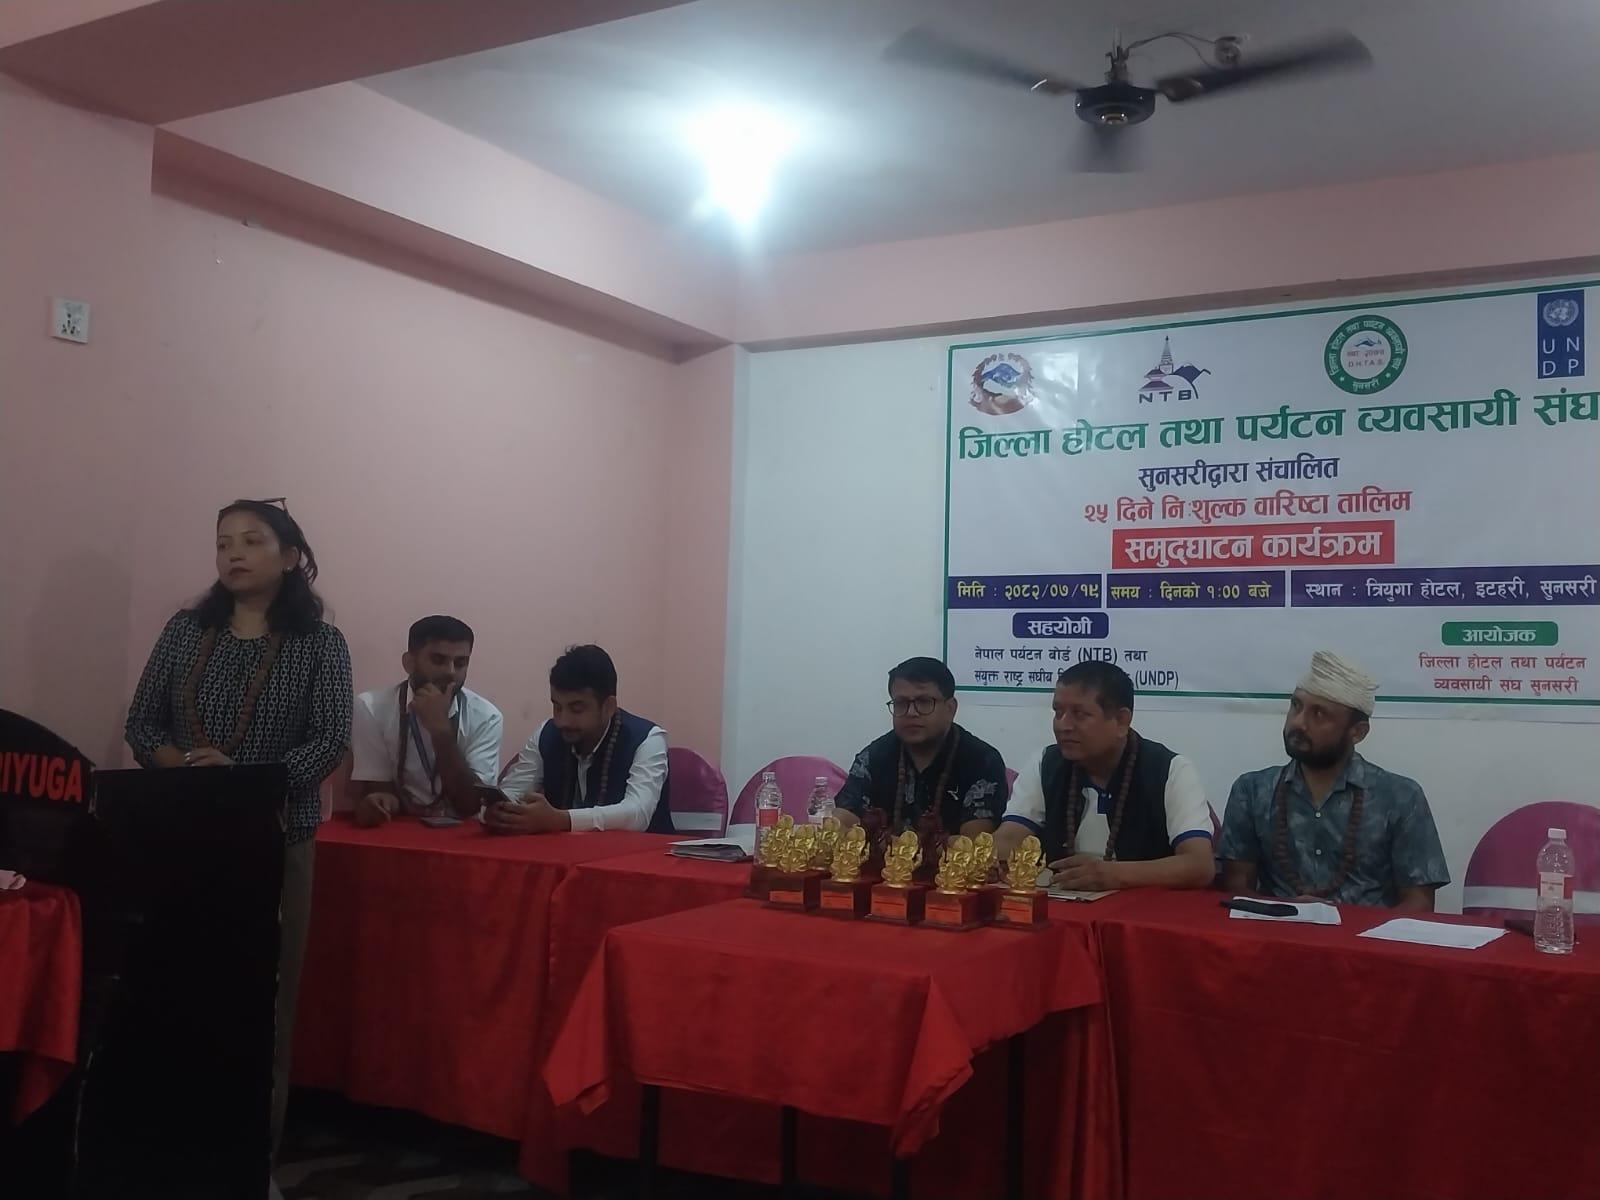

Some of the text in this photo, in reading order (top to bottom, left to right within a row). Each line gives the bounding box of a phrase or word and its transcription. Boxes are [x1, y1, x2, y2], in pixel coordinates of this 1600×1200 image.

[1139, 389, 1192, 404] NTB
[959, 387, 1600, 459] जिल्ला होटल तथा पर्यटन व्यवसायी संघ
[1138, 452, 1341, 492] सुनसरीद्वारा संचालित
[1084, 503, 1109, 524] २५
[1116, 496, 1154, 522] दिने
[1254, 489, 1330, 516] वारिष्टा
[1337, 485, 1412, 512] तालिम
[1262, 527, 1384, 560] कार्यक्रम
[957, 580, 986, 598] मिति
[1111, 585, 1141, 600] समय
[1160, 581, 1200, 601] दिनको
[1247, 580, 1272, 598] बजे
[1305, 583, 1343, 598] स्थान
[1366, 578, 1413, 602] त्रियुगा
[1540, 575, 1597, 601] सुनसरी
[1027, 617, 1093, 636] सहयोगी
[1462, 625, 1536, 643] आयोजक
[974, 646, 1005, 660] नेपाल
[1010, 645, 1043, 660] पर्यटन
[1078, 647, 1118, 665] (NTB)
[1124, 650, 1149, 661] तथा
[1419, 652, 1587, 671] जिल्ला होटल तथा पर्यटन
[1135, 670, 1179, 690] (UNDP)
[1434, 675, 1492, 692] व्यवसायी
[1530, 676, 1579, 696] सुनसरी
[0, 752, 82, 803] IYUGA
